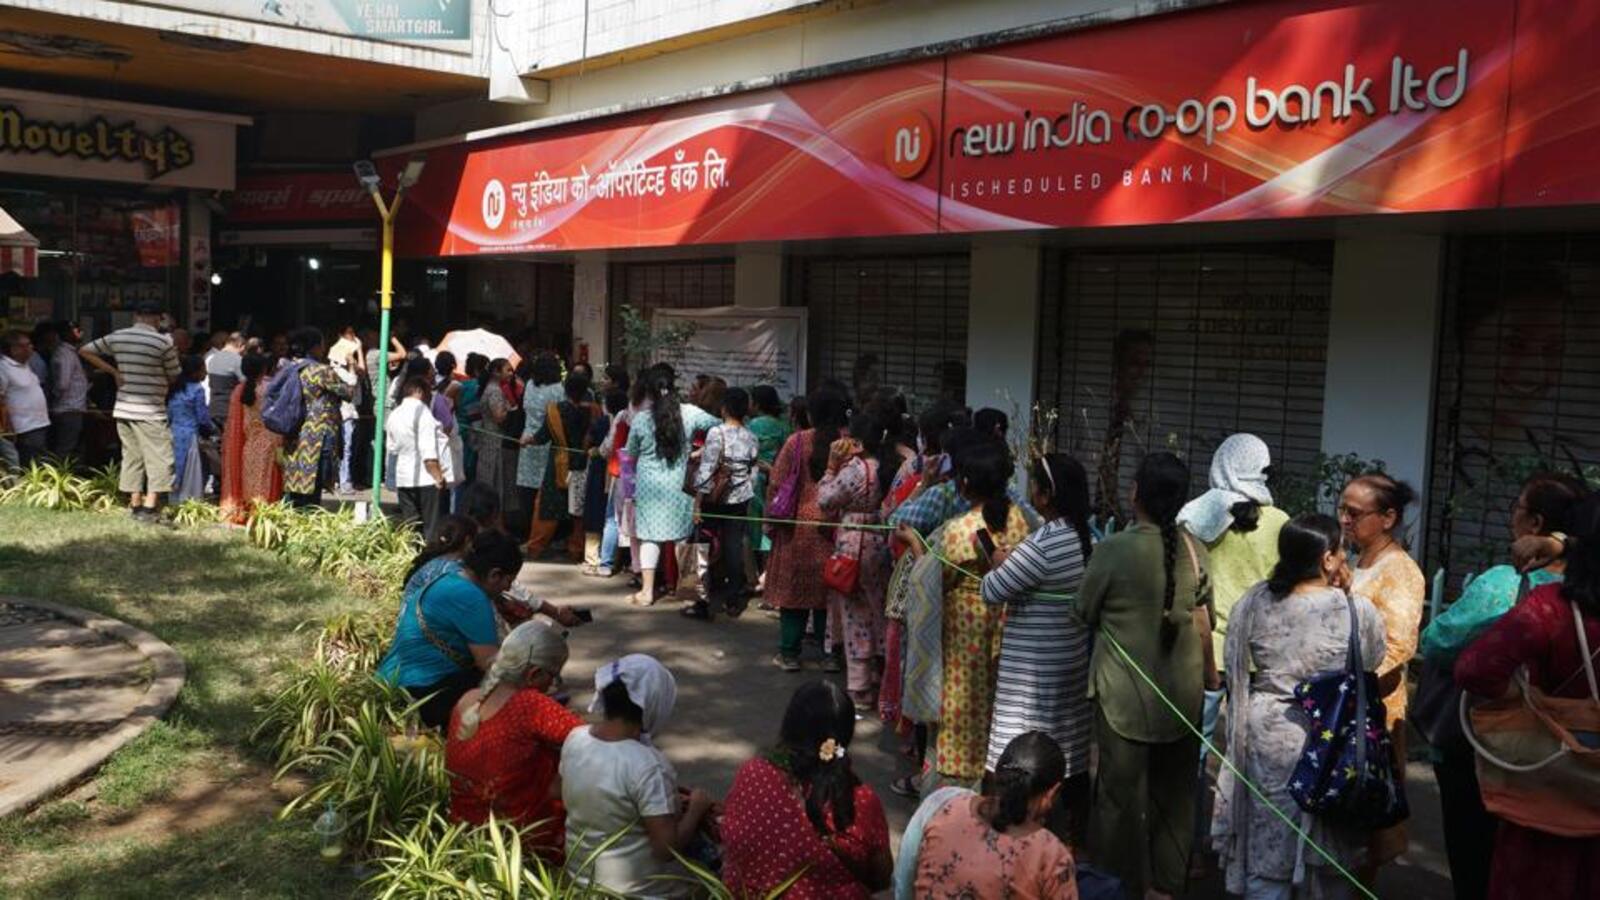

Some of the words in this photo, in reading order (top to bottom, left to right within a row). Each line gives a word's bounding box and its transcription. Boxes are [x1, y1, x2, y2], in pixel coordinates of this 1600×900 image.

[949, 121, 1015, 157] new
[1022, 101, 1111, 150] india
[1123, 95, 1237, 146] co-op
[1245, 63, 1375, 127] bank
[1389, 48, 1468, 112] ltd
